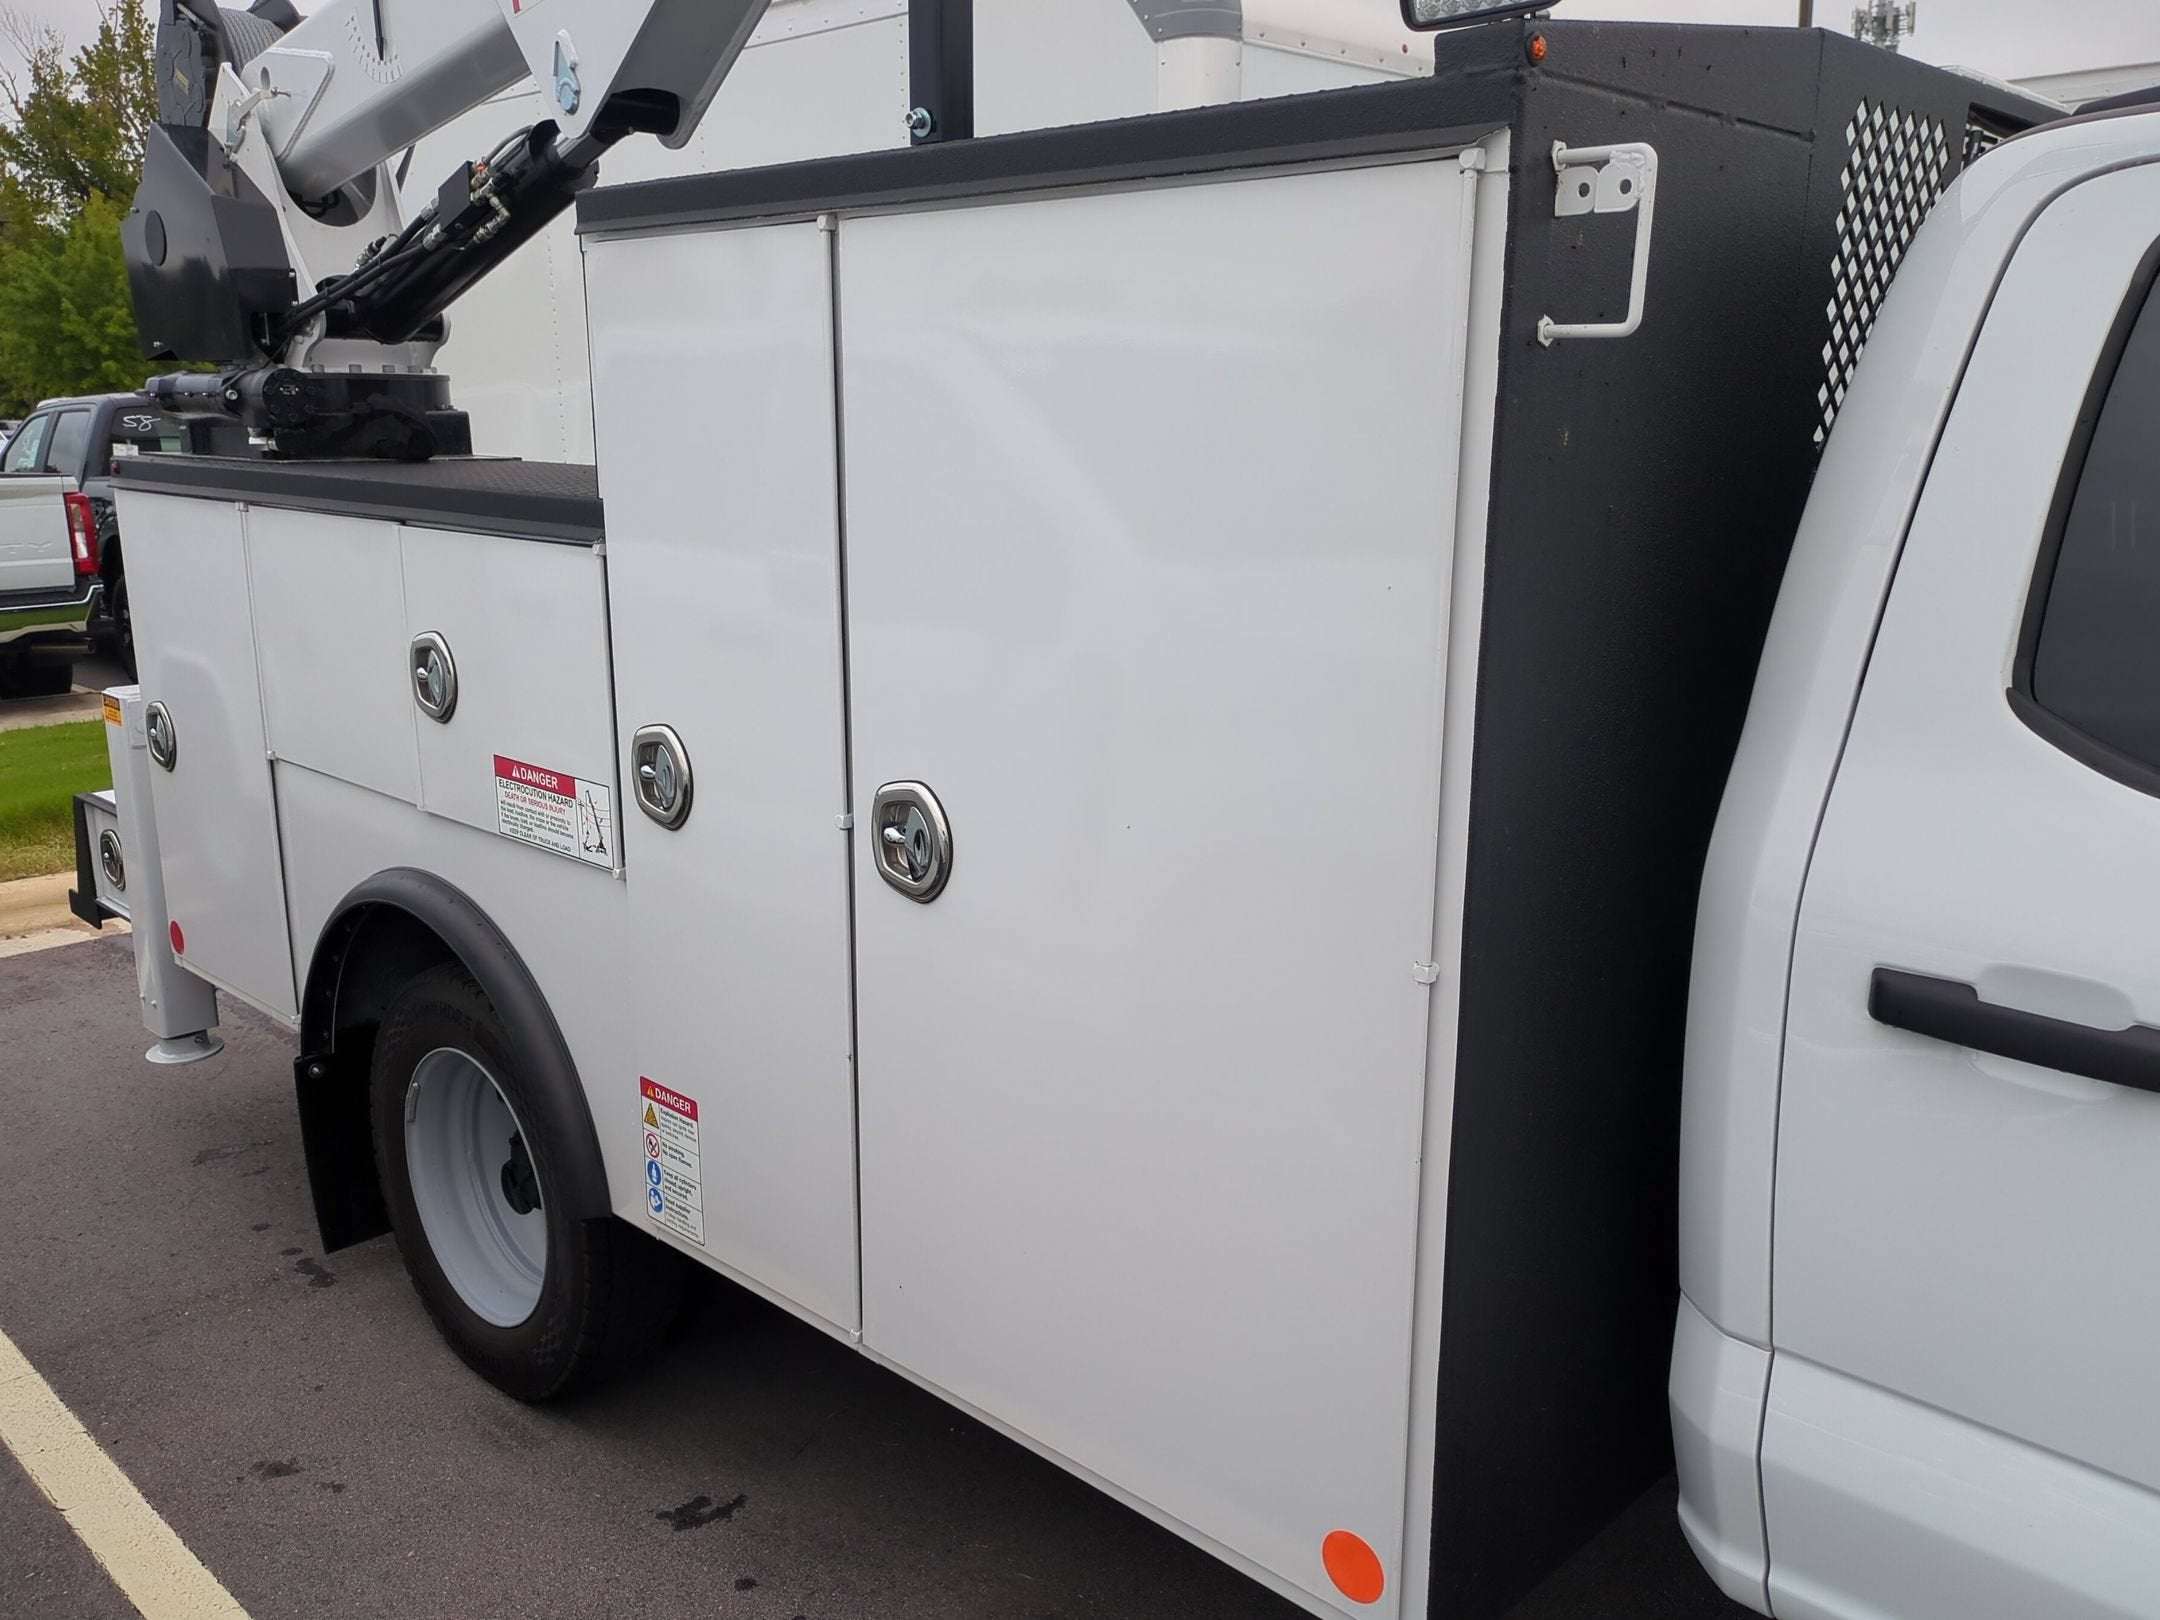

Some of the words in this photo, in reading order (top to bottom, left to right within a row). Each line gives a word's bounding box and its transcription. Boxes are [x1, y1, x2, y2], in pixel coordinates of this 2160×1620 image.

[520, 767, 558, 790] DANGER
[499, 779, 546, 800] ELECTROCUTION
[548, 793, 573, 808] HAZARD
[505, 791, 519, 801] DEATH
[528, 798, 547, 810] SERIOUS
[549, 804, 565, 815] INJURY
[519, 831, 531, 839] CLEAR
[538, 837, 550, 845] TRUCK
[560, 844, 571, 852] LOAD
[655, 1088, 691, 1114] DANGER
[661, 1108, 678, 1121] Explosion
[679, 1177, 696, 1190] cylinders
